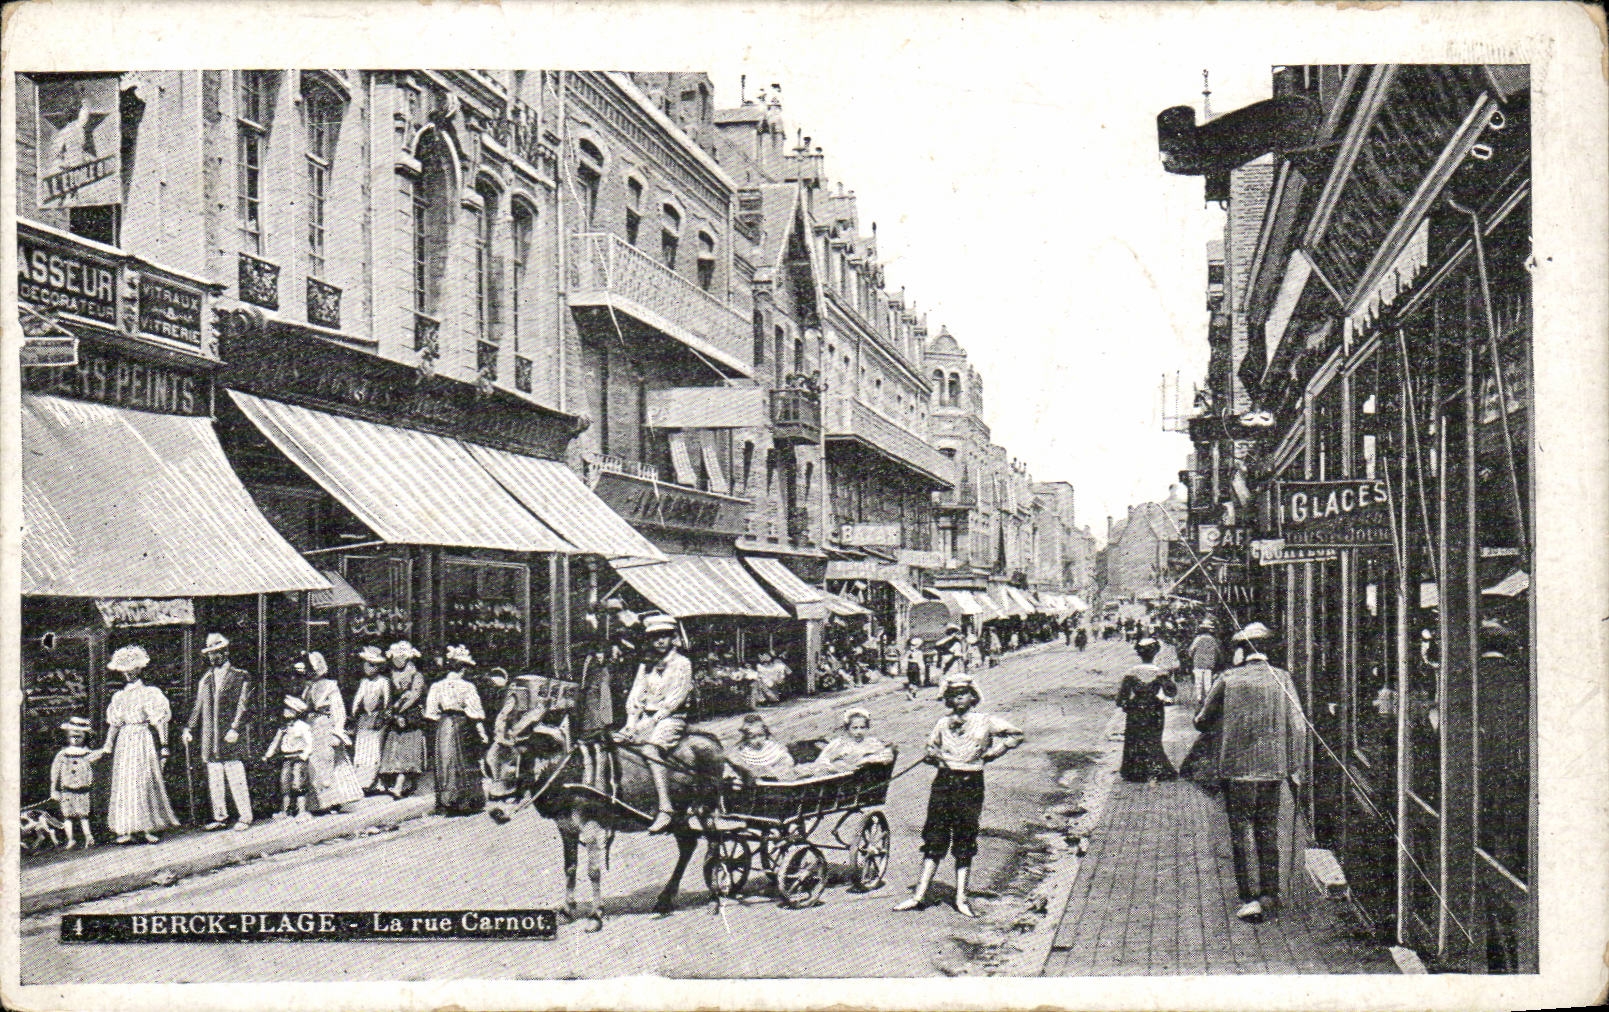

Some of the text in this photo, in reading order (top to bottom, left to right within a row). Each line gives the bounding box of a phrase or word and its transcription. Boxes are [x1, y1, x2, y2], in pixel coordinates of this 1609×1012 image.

[143, 284, 198, 311] VITRAUX
[141, 316, 201, 343] VITRERIE
[116, 362, 194, 414] PEINTS
[1291, 481, 1388, 522] GLACES
